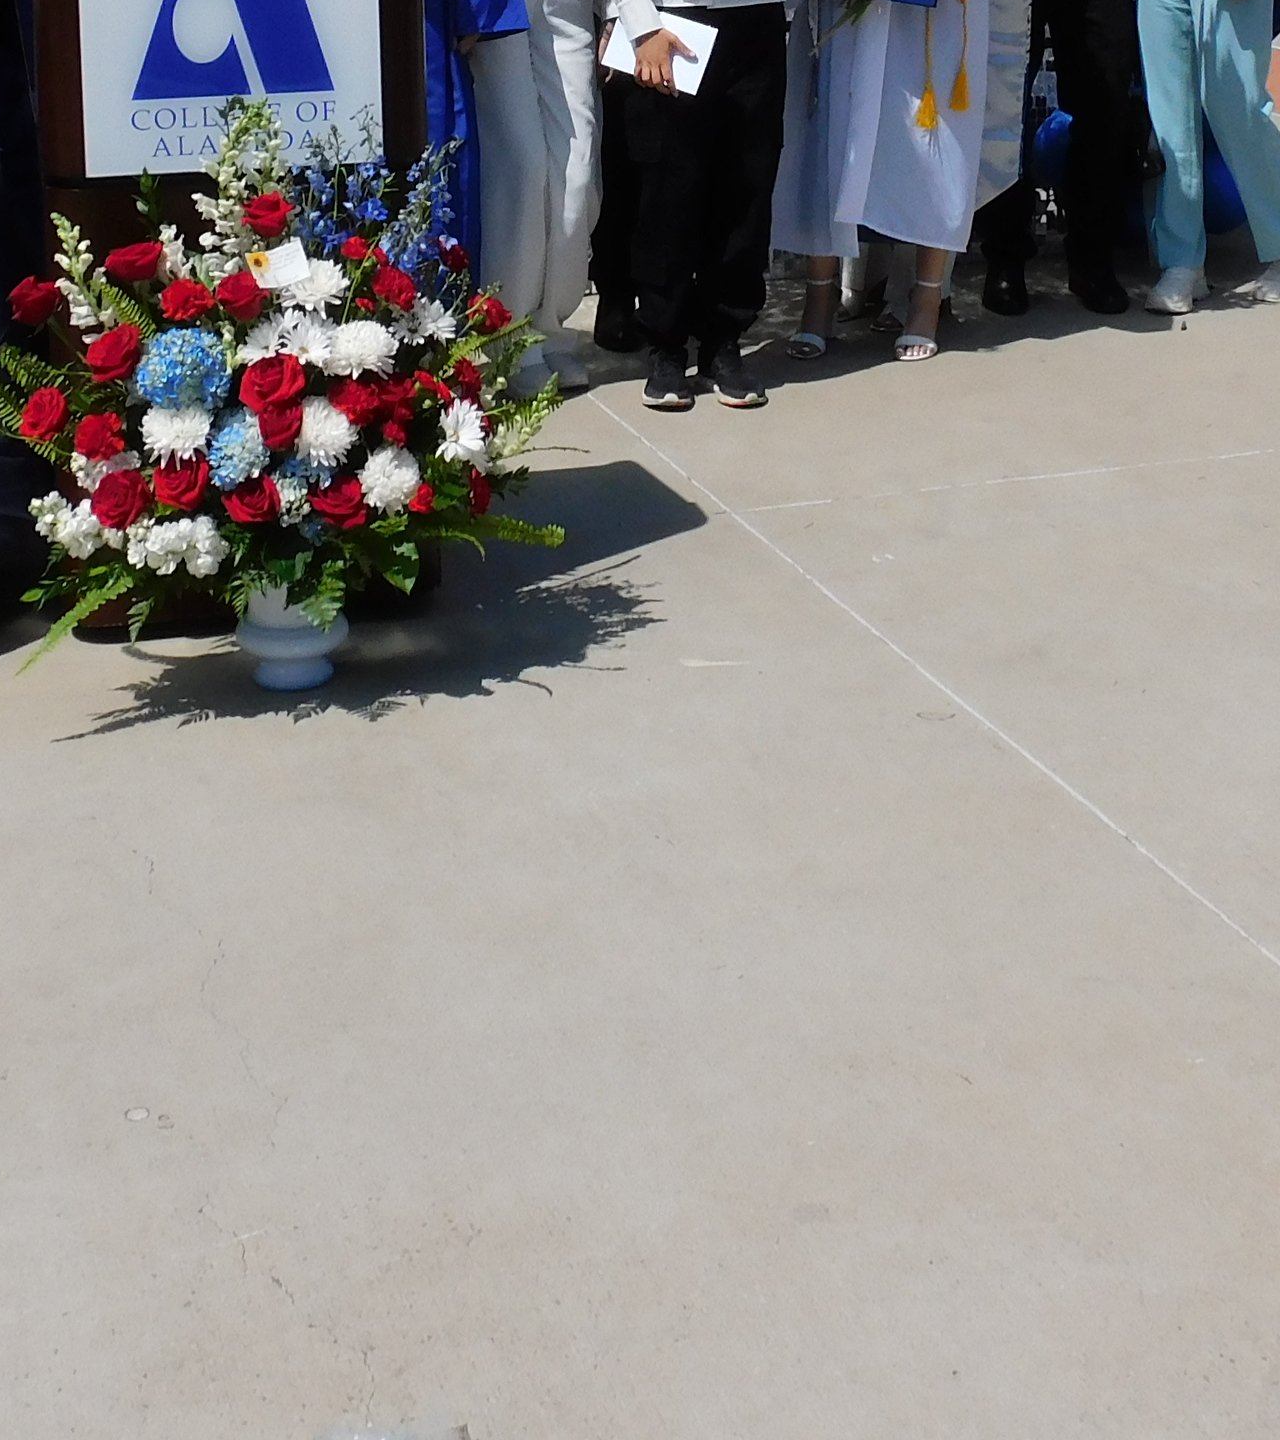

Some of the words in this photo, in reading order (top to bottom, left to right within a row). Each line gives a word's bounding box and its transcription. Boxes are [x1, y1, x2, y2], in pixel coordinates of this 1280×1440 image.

[130, 101, 282, 131] COLLE
[295, 100, 337, 124] OF
[152, 129, 316, 158] ALAEDA
